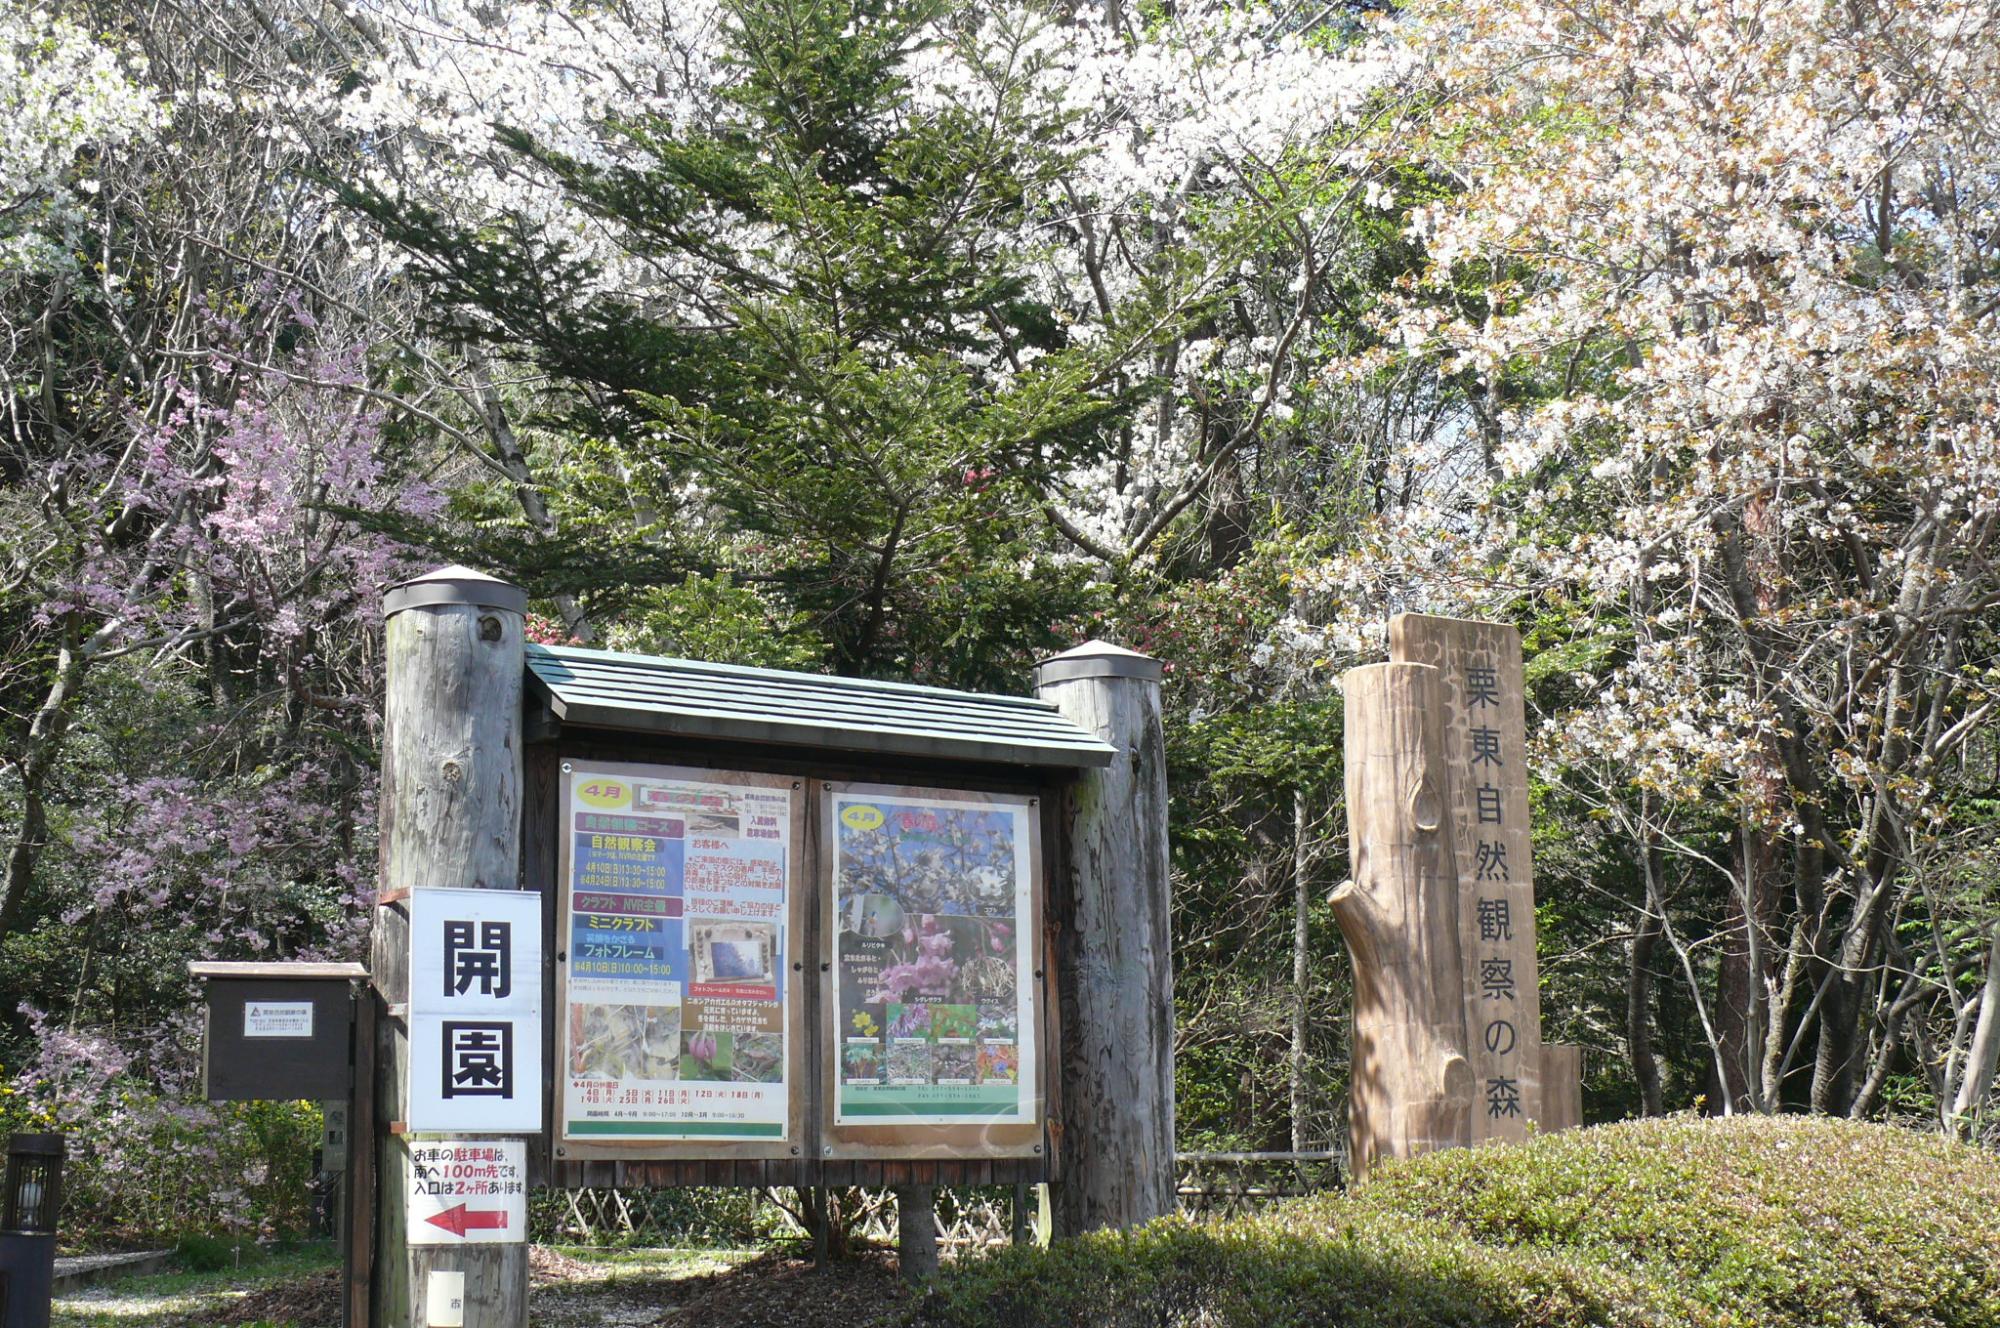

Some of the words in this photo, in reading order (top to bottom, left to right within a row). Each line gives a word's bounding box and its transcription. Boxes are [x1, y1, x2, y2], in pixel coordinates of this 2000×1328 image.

[584, 784, 621, 799] 4月
[847, 811, 876, 823] 4月
[591, 835, 656, 853] 自然観察会
[692, 839, 729, 850] お客様へ
[581, 892, 617, 909] クラフト
[1464, 667, 1521, 1119] 栗東自然観察の森
[589, 915, 654, 932] ミニクラフト
[584, 944, 655, 959] フォトフレーム
[442, 920, 513, 1100] 開園
